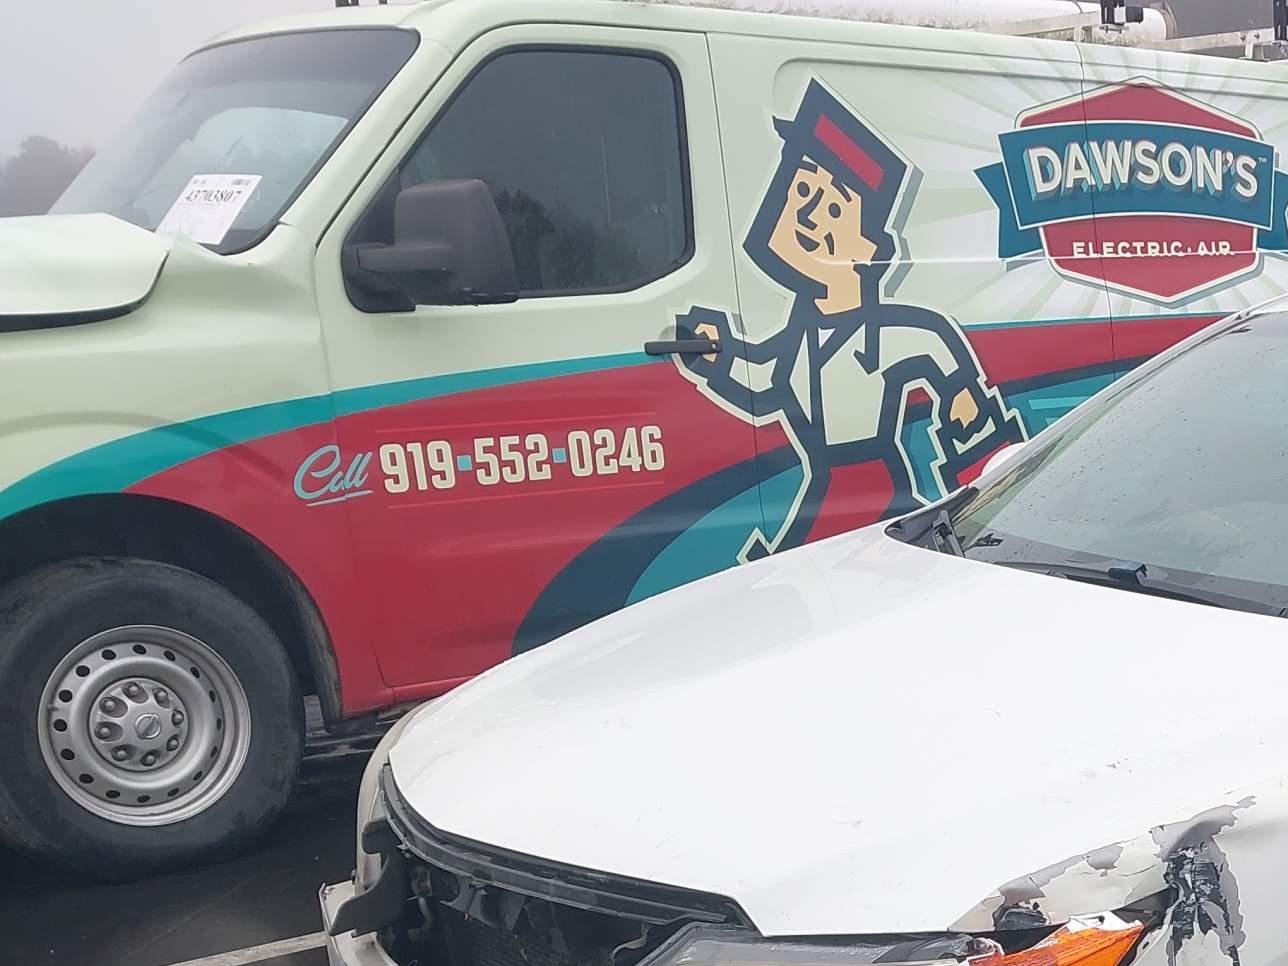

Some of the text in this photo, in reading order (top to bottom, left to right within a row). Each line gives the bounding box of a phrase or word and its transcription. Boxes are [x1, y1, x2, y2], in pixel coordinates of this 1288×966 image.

[1023, 141, 1258, 199] DAWSON'S
[1072, 241, 1235, 257] ELECTRIC AIR
[293, 444, 373, 500] Call
